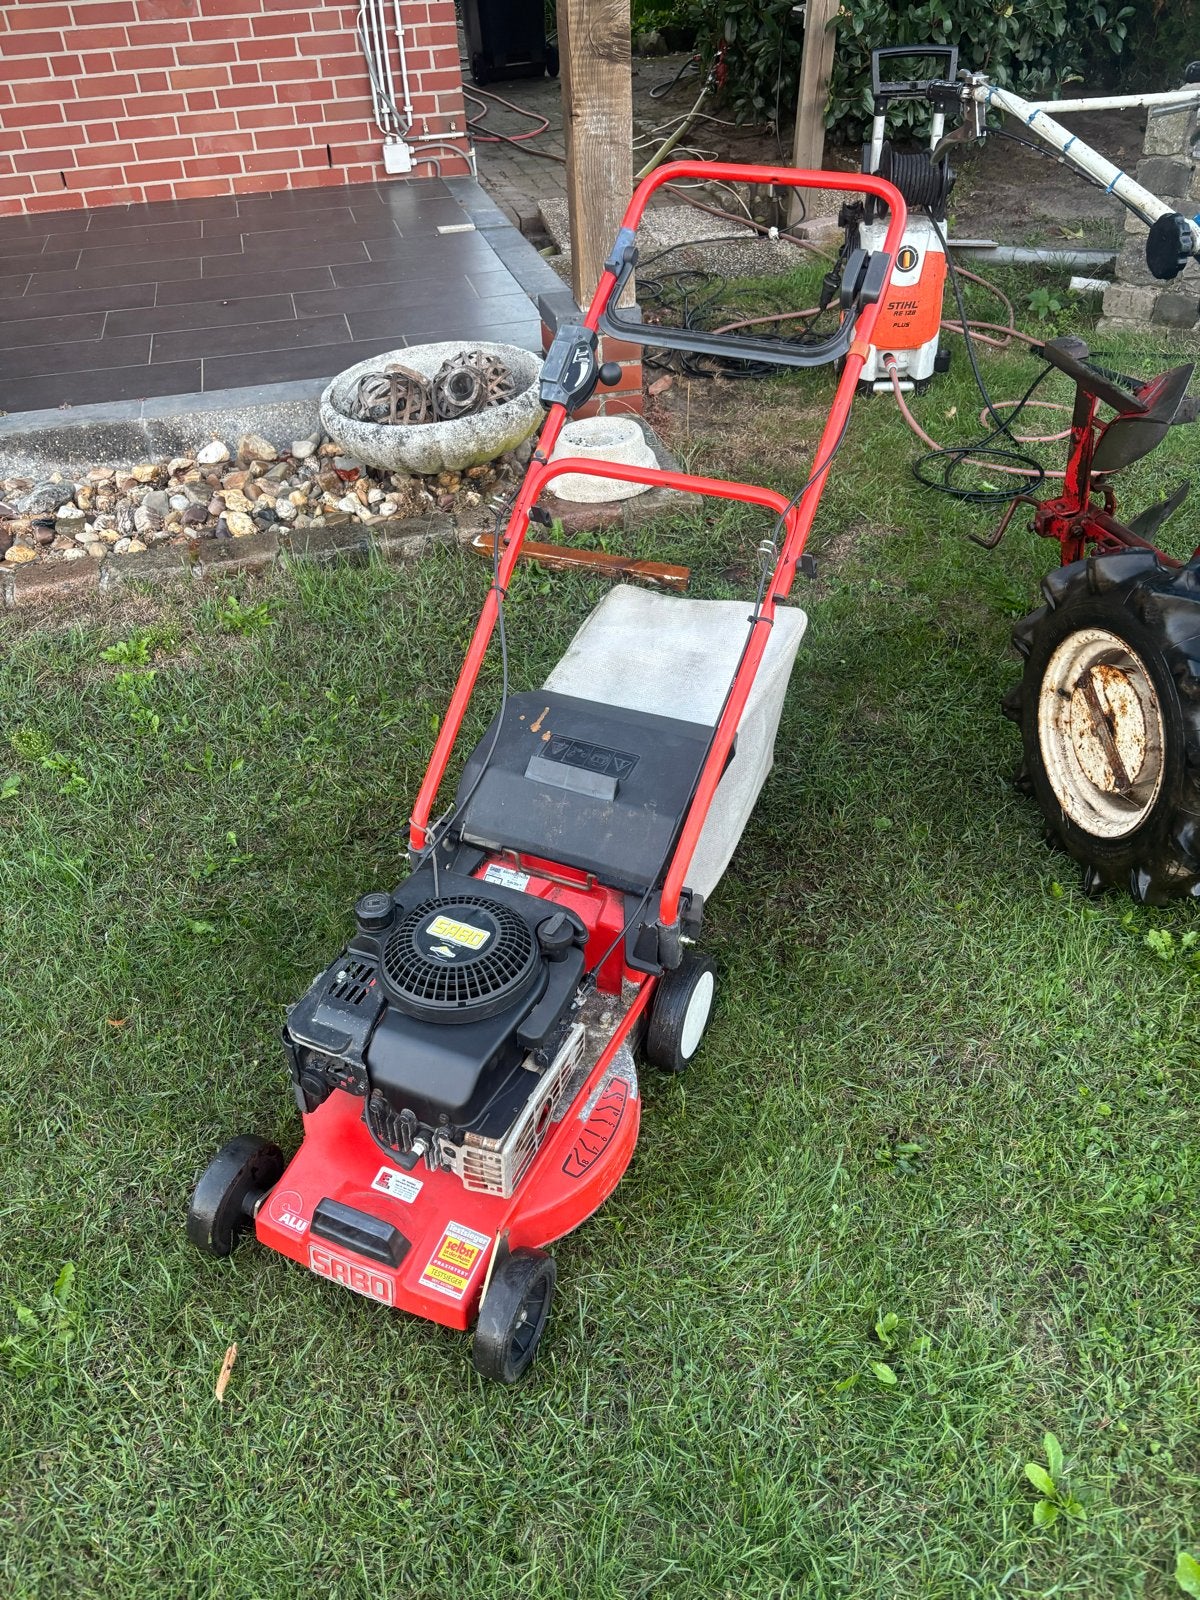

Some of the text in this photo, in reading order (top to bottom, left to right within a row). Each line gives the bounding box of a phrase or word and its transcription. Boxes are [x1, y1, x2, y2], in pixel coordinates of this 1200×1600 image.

[887, 301, 918, 310] STIHL
[431, 921, 486, 947] SABO
[278, 1213, 308, 1232] ALU
[449, 1223, 488, 1244] Testsieger
[446, 1240, 475, 1259] selbst
[312, 1249, 390, 1301] SABO
[430, 1268, 463, 1287] TESTSIEGER
